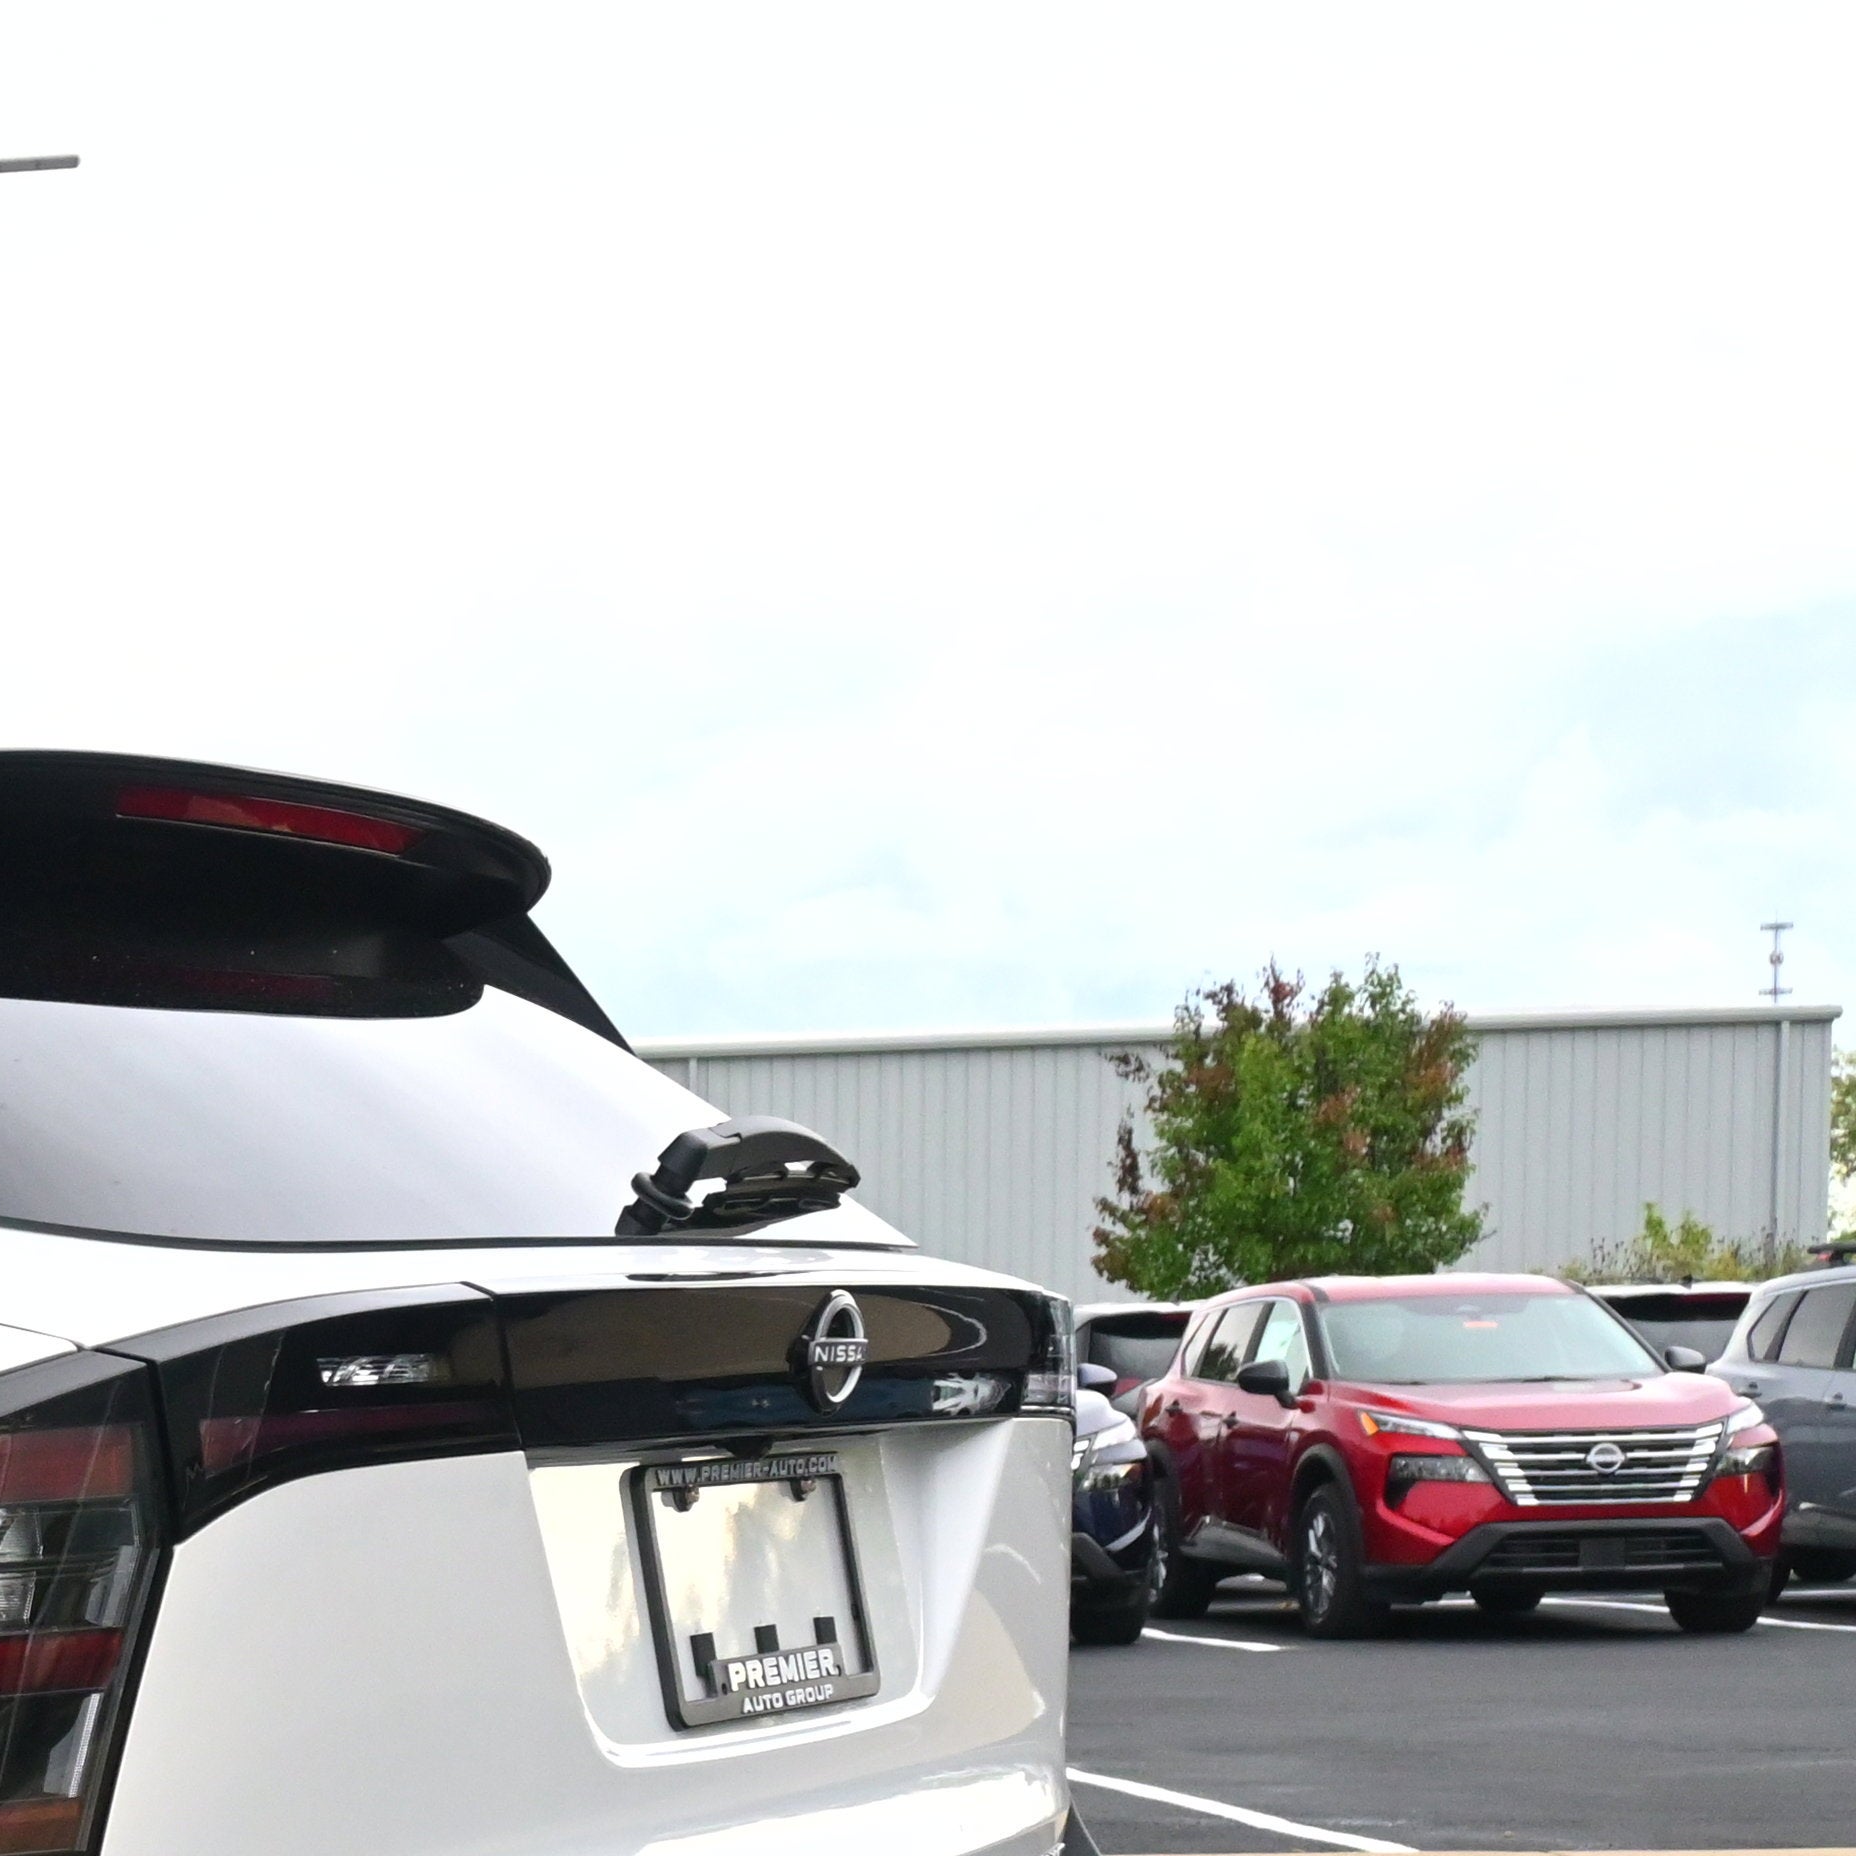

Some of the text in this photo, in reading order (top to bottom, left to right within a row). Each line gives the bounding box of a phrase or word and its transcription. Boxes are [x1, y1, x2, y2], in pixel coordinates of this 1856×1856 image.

[814, 1345, 865, 1363] NISSA
[657, 1456, 838, 1486] WWW.PREMIER-AUTO.COM
[728, 1648, 839, 1692] PREMIER
[743, 1684, 834, 1714] AUTO GROUP
